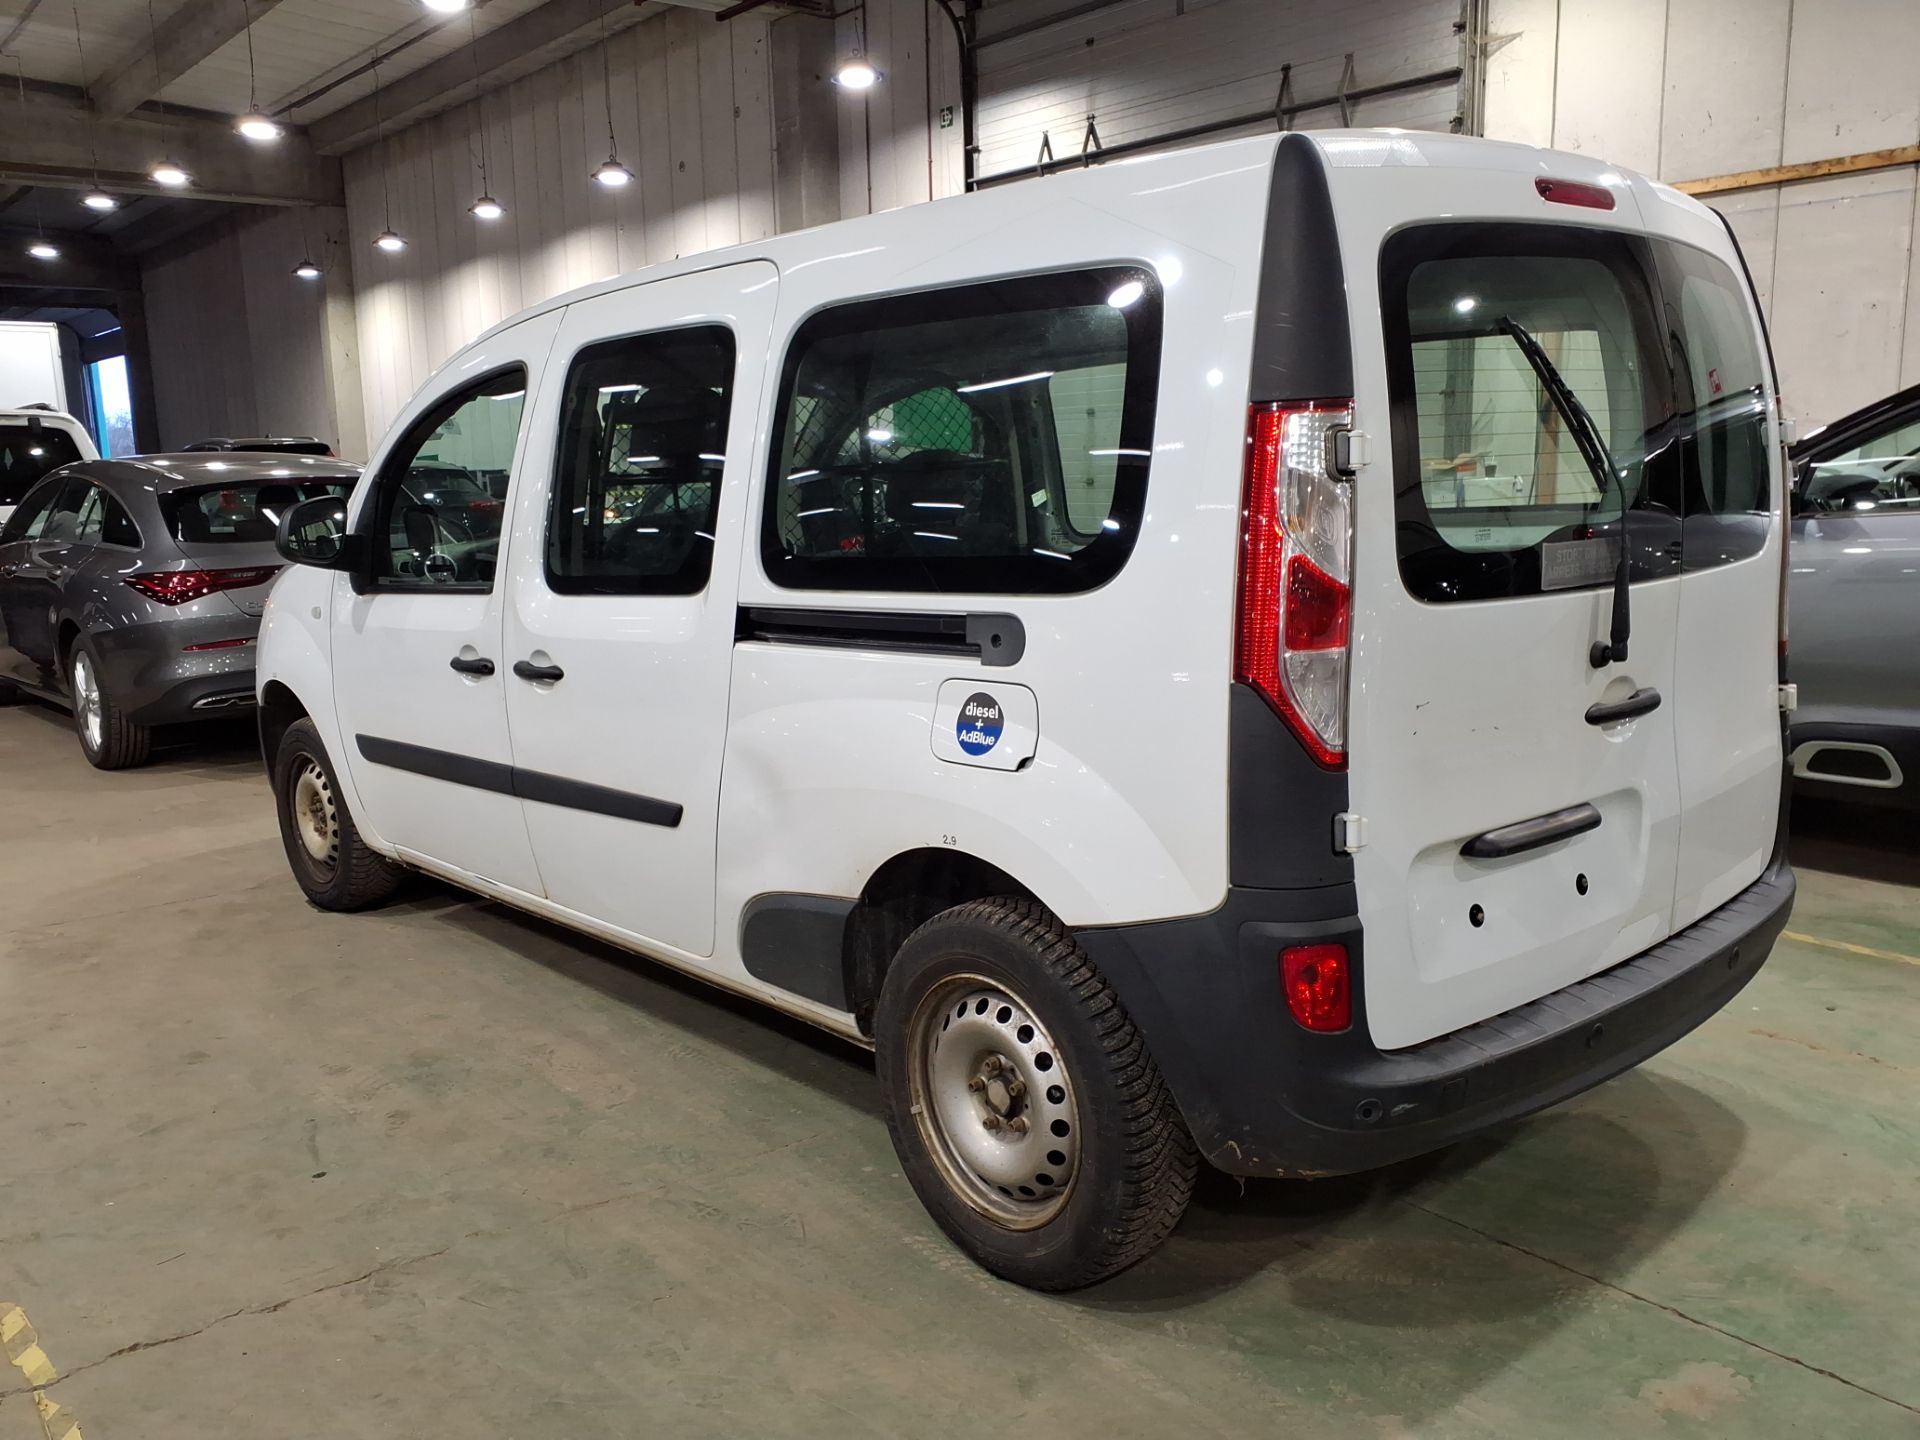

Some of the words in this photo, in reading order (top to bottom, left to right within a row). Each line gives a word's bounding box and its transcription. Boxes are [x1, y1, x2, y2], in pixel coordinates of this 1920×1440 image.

[965, 702, 999, 719] diesel
[975, 718, 984, 730] +
[959, 729, 995, 746] AdBlue
[942, 834, 957, 846] 2.9
